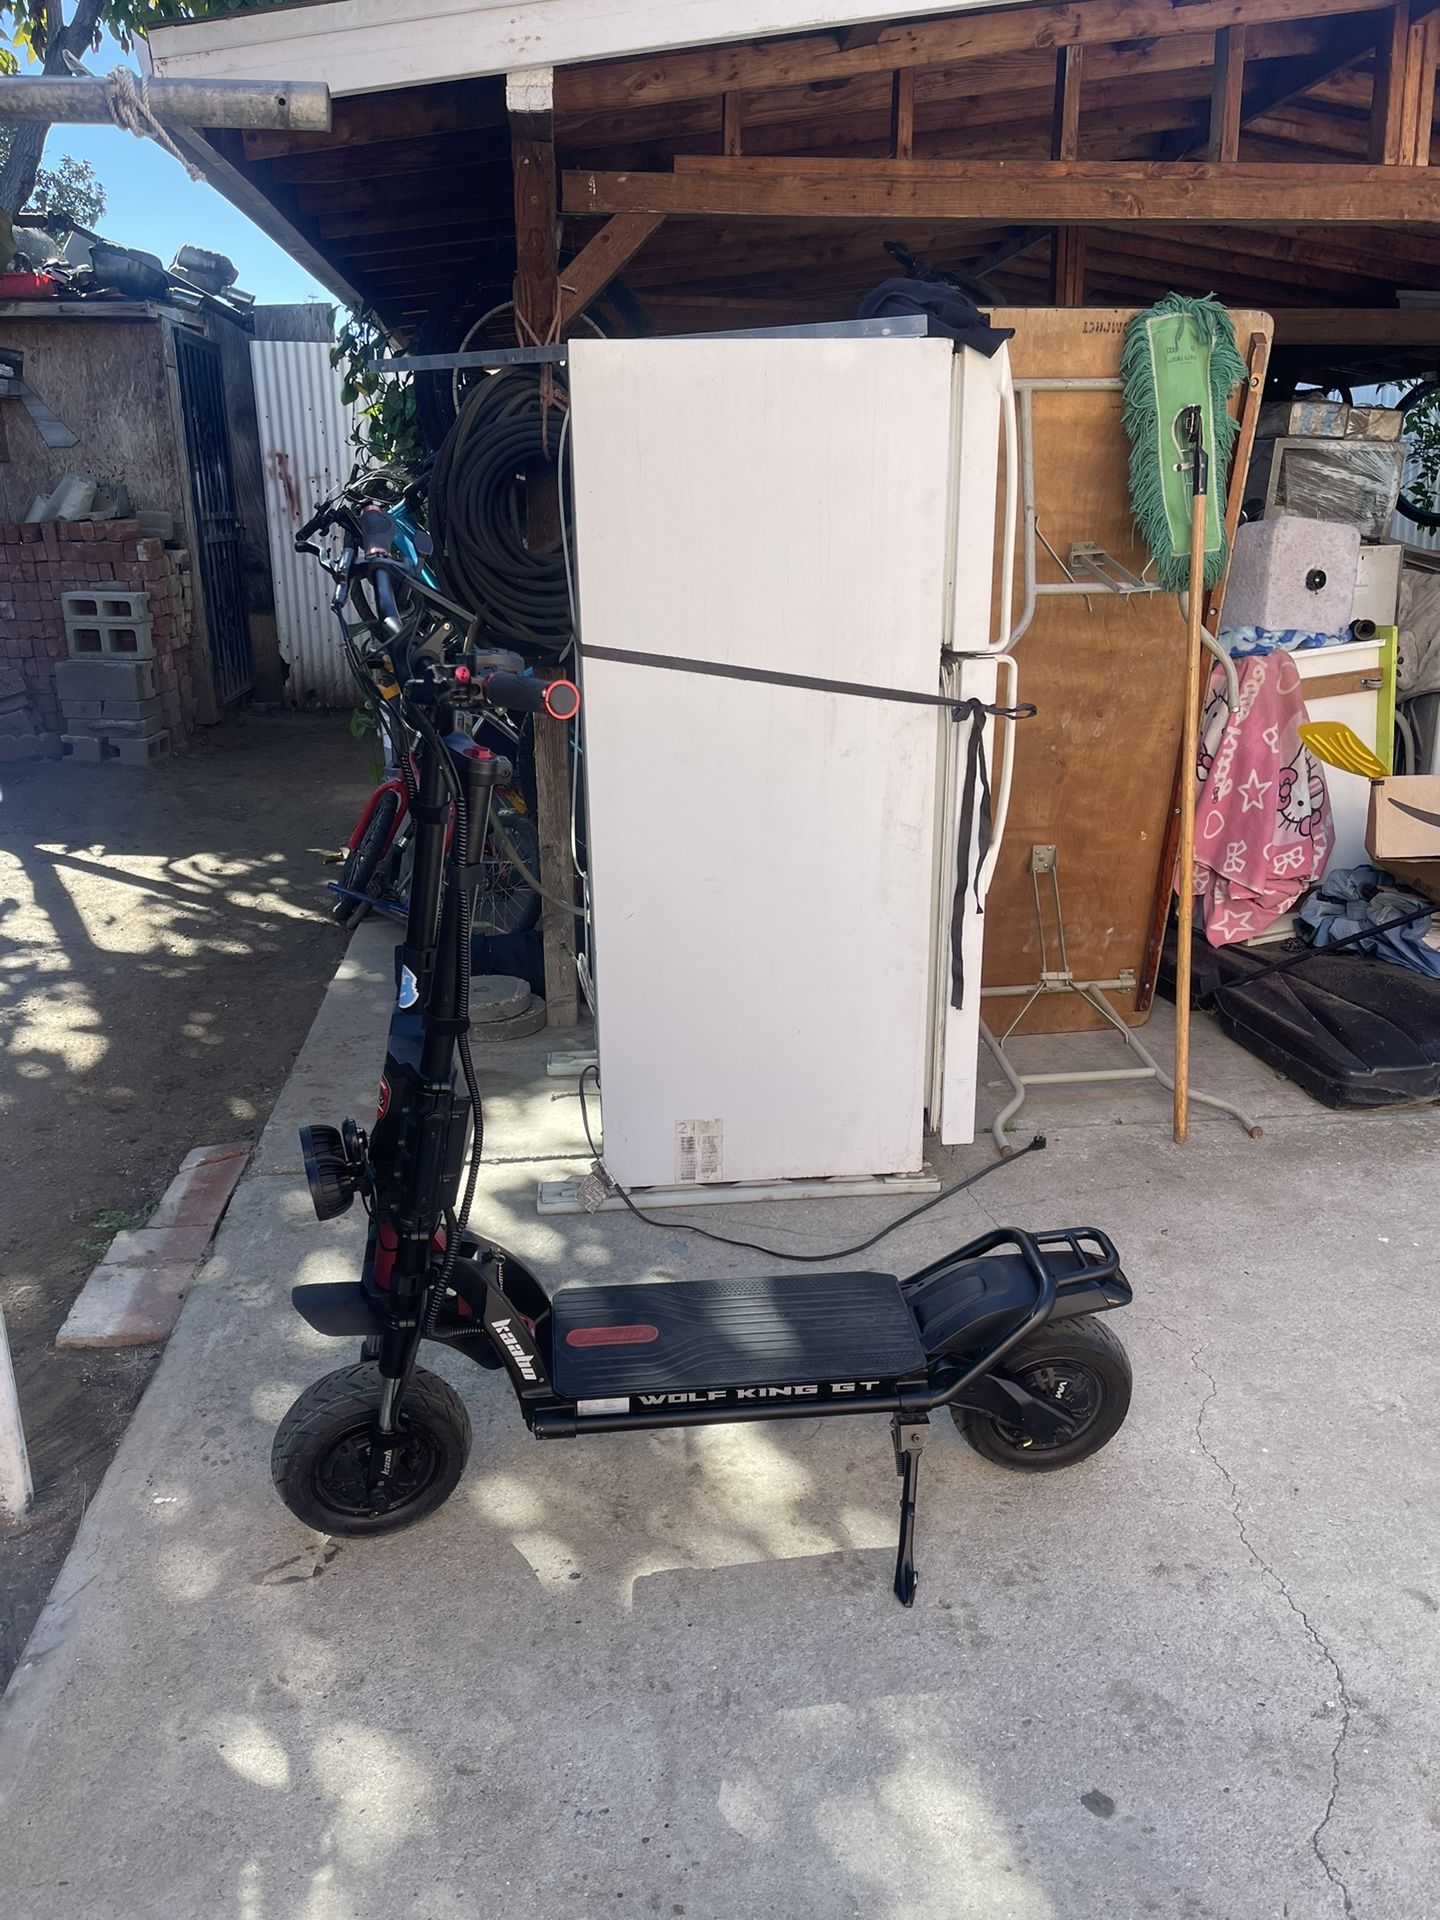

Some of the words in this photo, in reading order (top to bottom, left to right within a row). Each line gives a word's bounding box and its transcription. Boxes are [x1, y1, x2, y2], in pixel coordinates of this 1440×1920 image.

[491, 1318, 538, 1380] kaabo
[639, 1390, 727, 1405] WOLF
[736, 1384, 819, 1398] KING
[830, 1381, 880, 1393] GT
